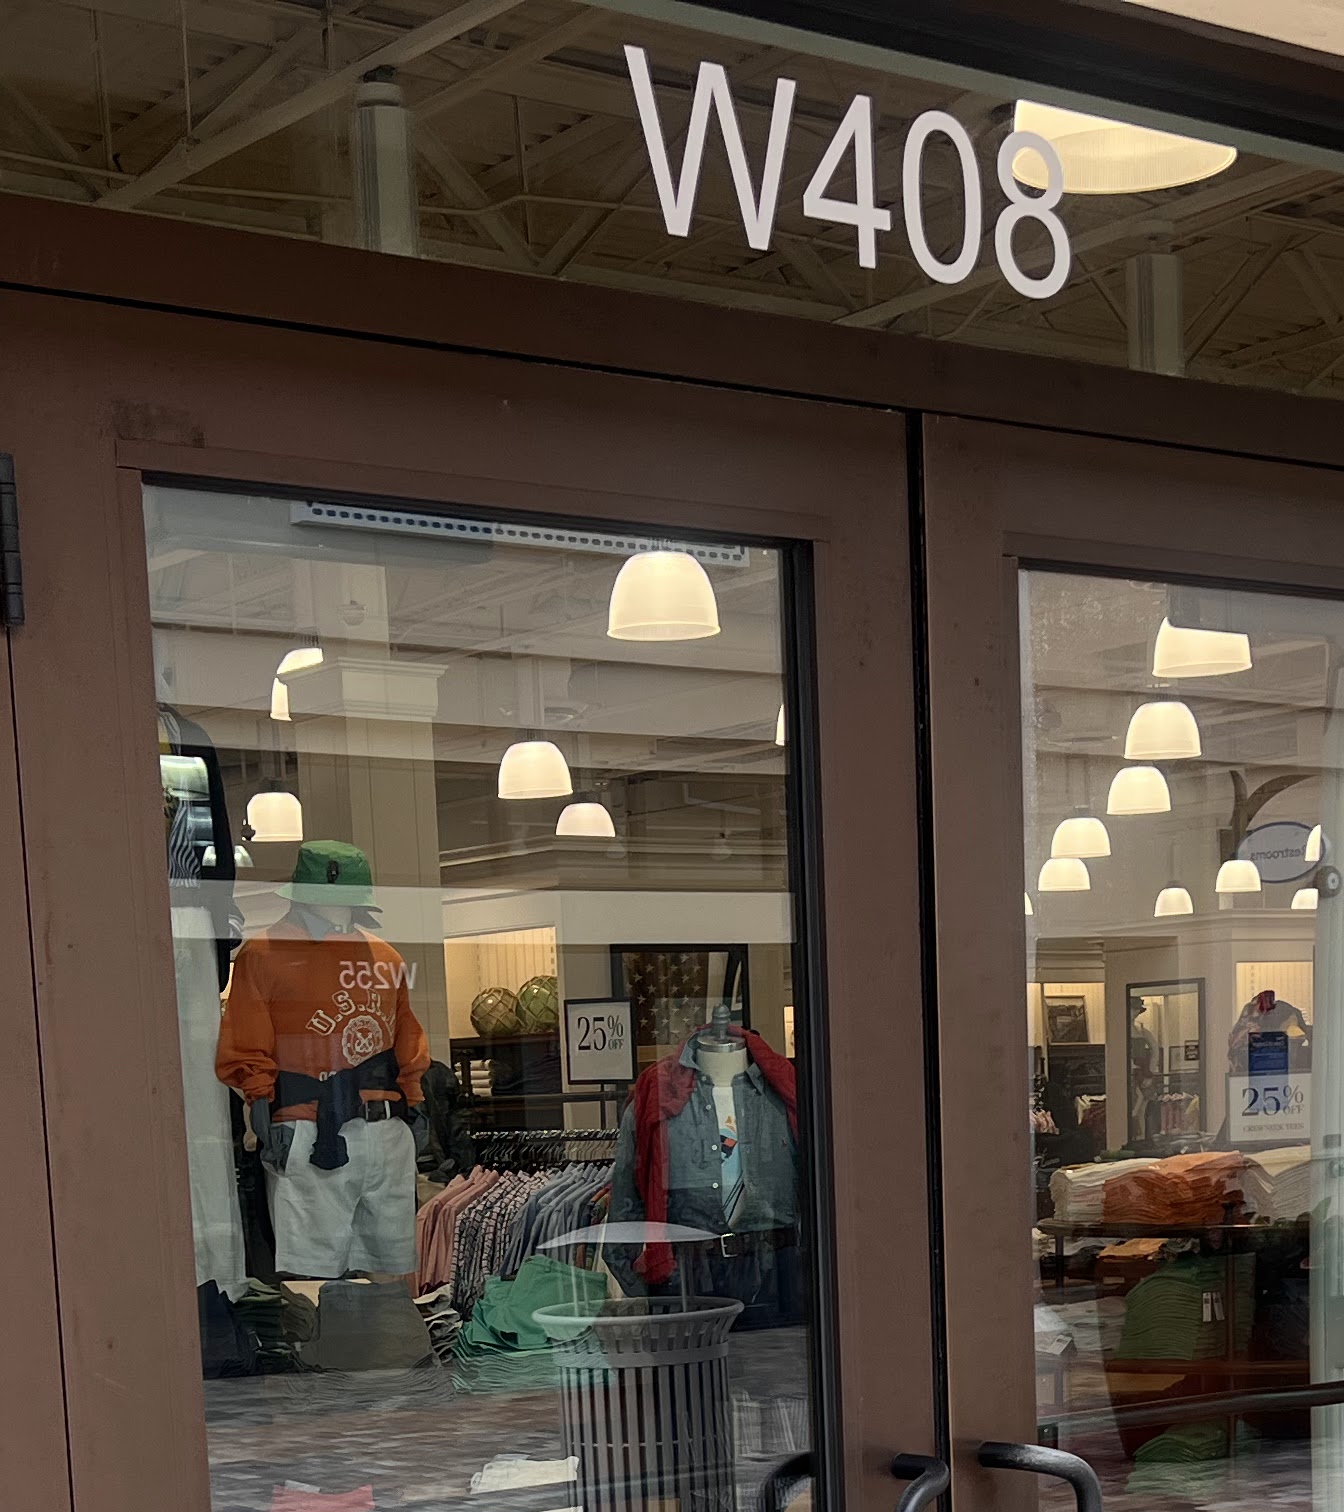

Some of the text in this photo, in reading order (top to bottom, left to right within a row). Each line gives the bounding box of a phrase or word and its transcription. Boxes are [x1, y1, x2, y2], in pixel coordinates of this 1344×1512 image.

[623, 44, 1071, 299] W408
[577, 1015, 624, 1051] 25%
[1241, 1085, 1304, 1116] 25%
[1283, 1104, 1303, 1115] OFF
